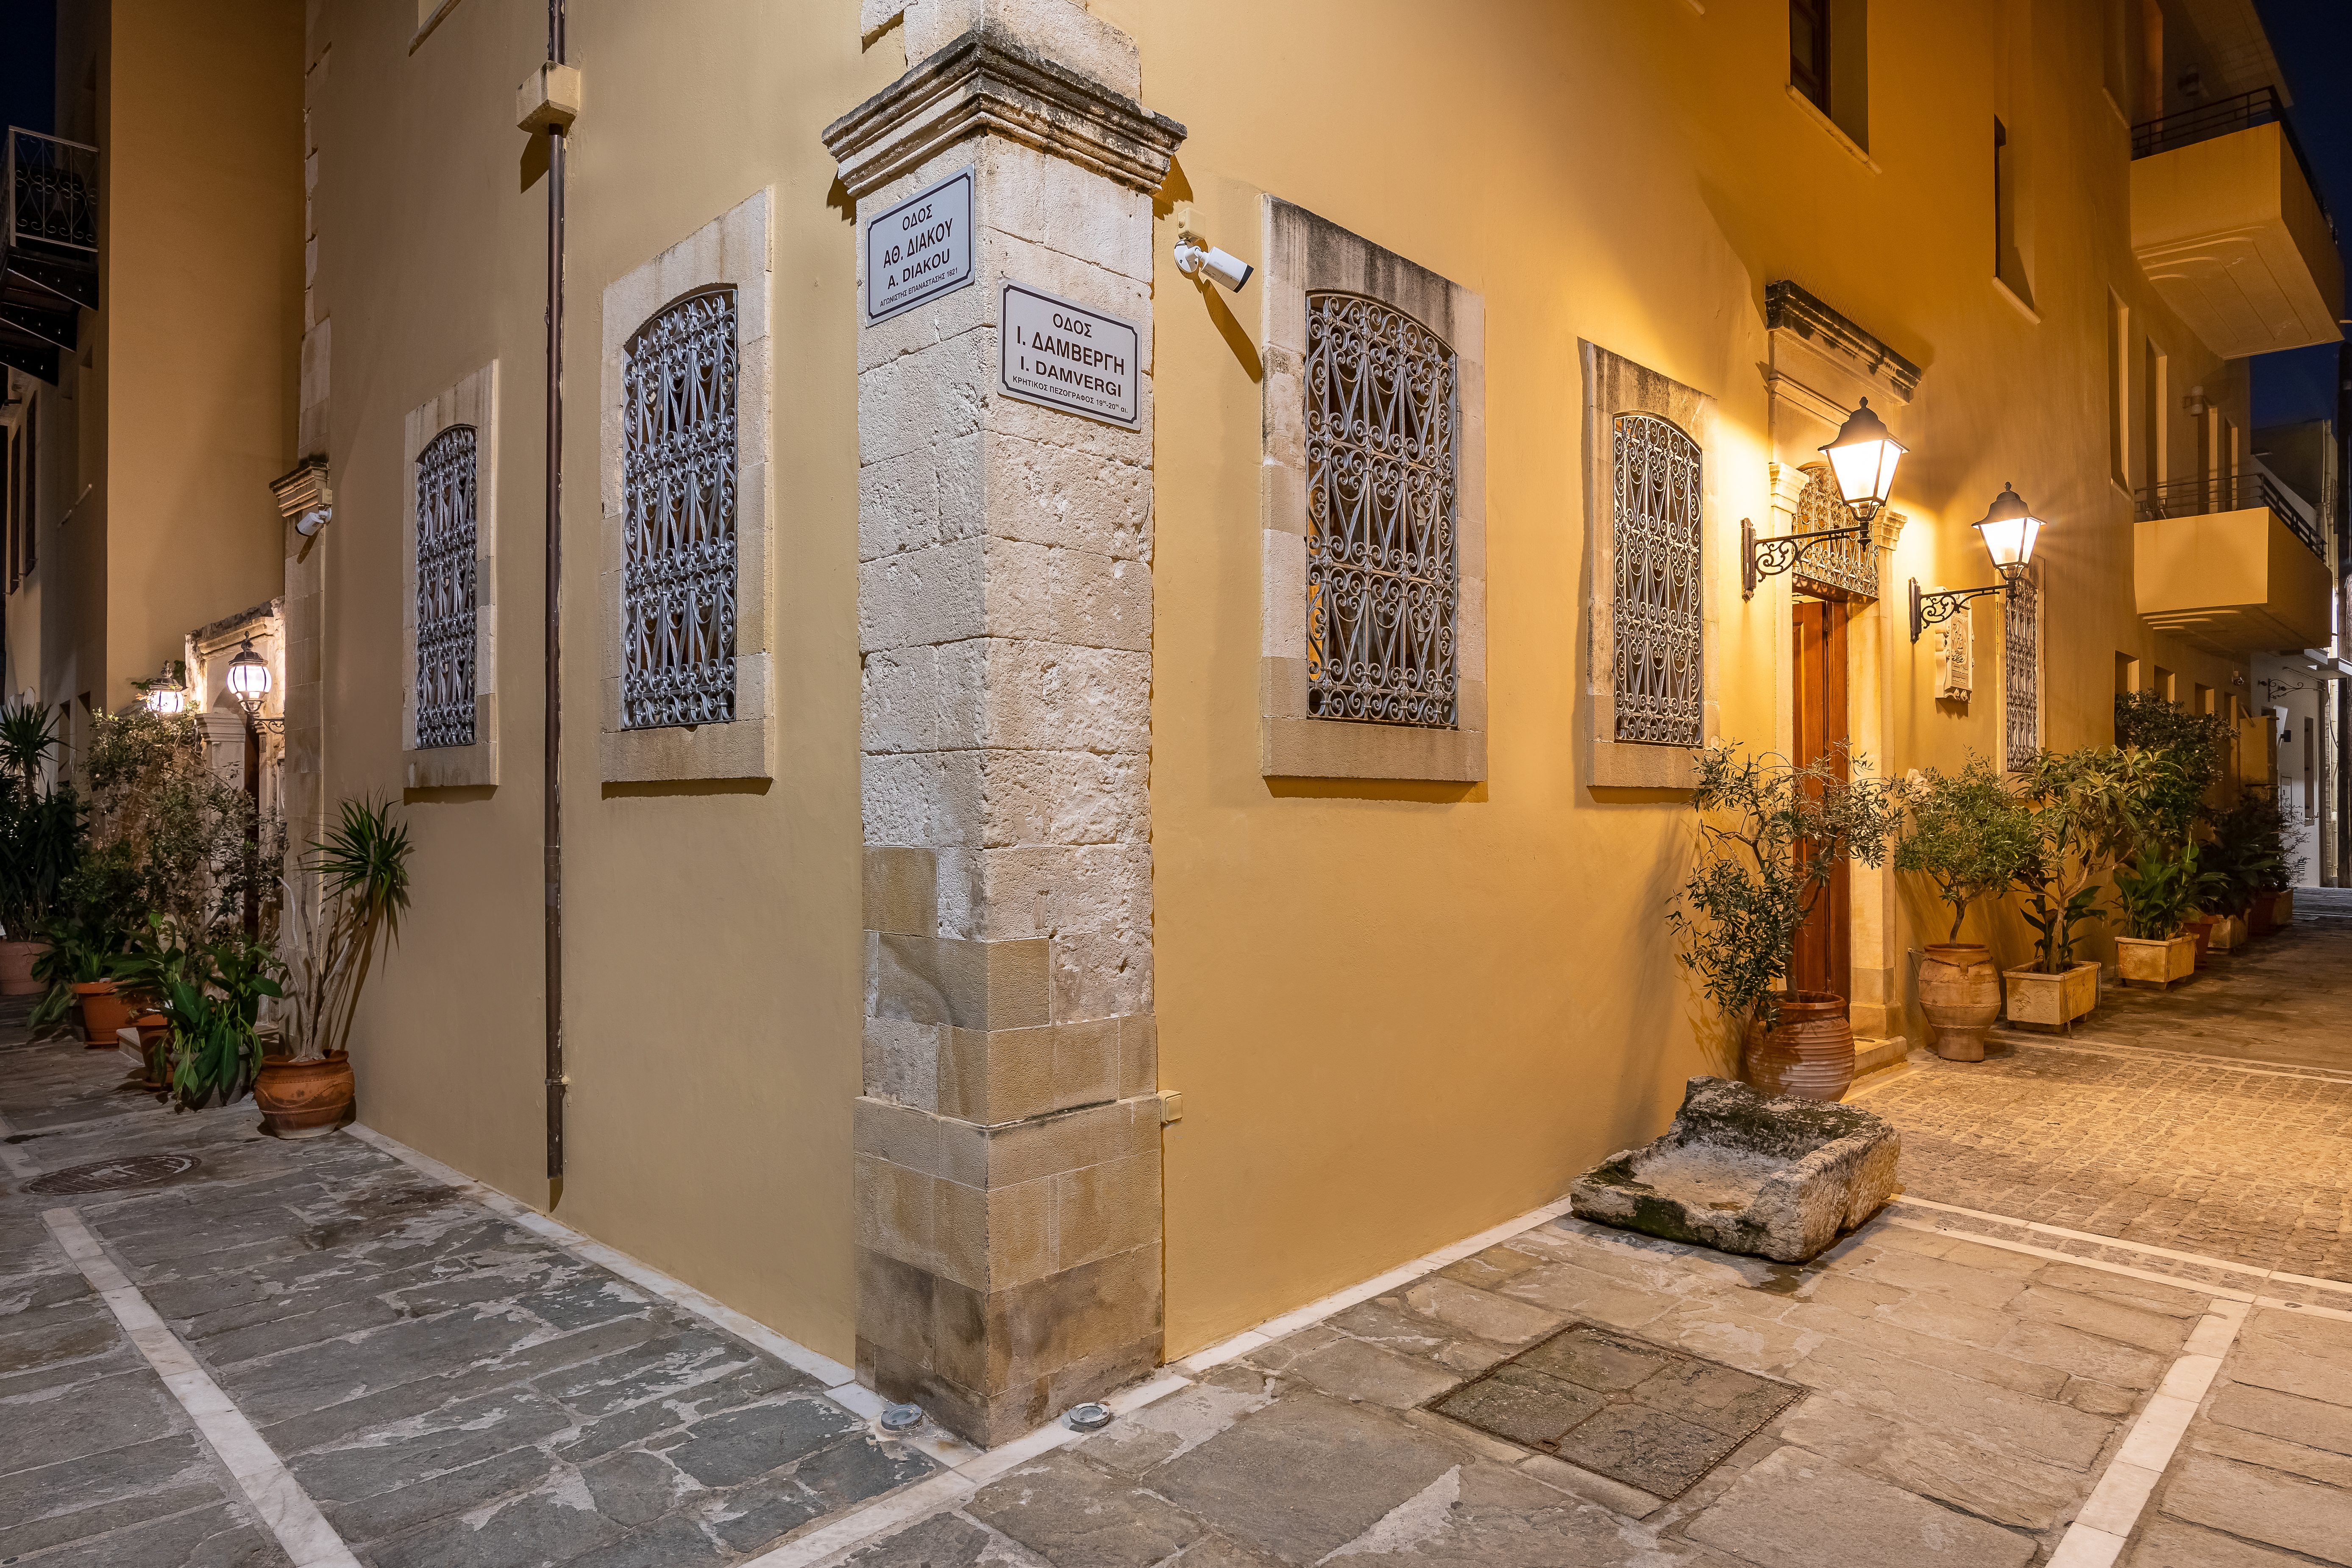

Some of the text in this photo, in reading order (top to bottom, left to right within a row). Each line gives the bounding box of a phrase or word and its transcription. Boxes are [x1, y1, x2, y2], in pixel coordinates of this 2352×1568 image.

[902, 204, 933, 231] ΟΔΟΣ
[883, 218, 953, 269] ΑΘ. ΔΙΑΚΟΥ
[880, 267, 958, 307] ΑΓΩΝΙΣΤΗΣ ΕΠΑΝΑΣΤΑΣΗΣ 1821
[887, 248, 950, 290] A. DIAKOU
[1053, 313, 1092, 338] ΟΔΟΣ
[1032, 331, 1125, 376] ΔΑΜΒΕΡΓΗ
[1013, 375, 1048, 391] ΚΡΗΤΙΚΟΣ
[1049, 386, 1094, 404] ΠΕΖΟΓΡΑΦΟΣ
[1020, 356, 1122, 398] I. DAMVERGI
